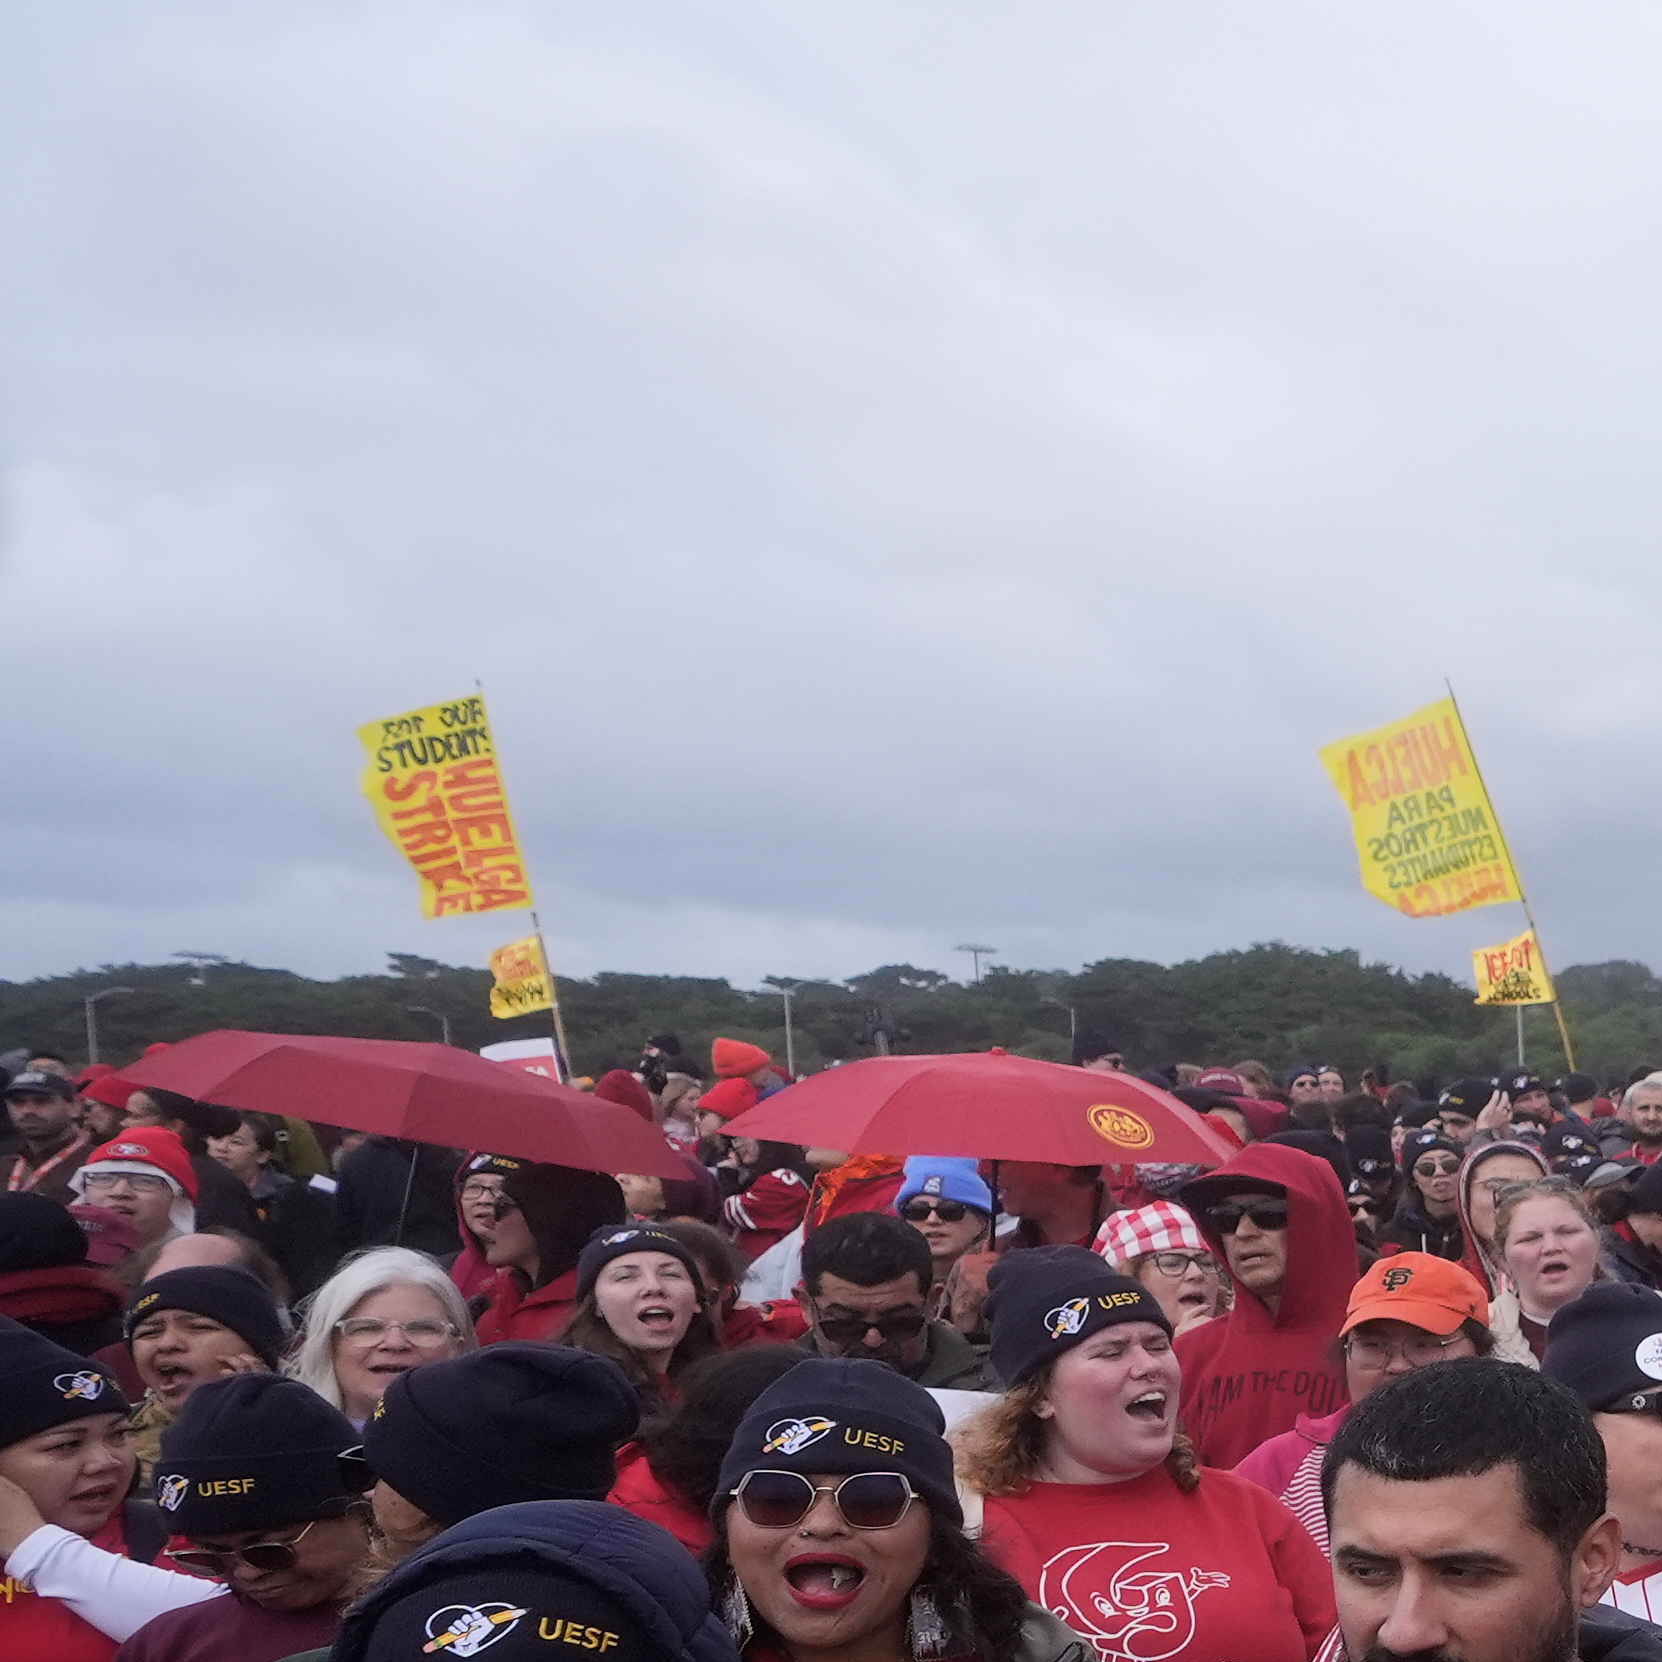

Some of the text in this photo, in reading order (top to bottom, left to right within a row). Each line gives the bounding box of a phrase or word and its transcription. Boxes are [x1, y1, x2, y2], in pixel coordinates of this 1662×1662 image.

[377, 727, 491, 773] STUDENTS
[384, 771, 475, 918] STRIKE
[442, 758, 528, 912] HUELGA
[1382, 1267, 1413, 1292] SF
[1097, 1289, 1143, 1312] UESF
[1252, 1370, 1290, 1393] THE
[843, 1426, 906, 1456] UESF
[197, 1477, 256, 1497] UESF
[537, 1616, 620, 1655] UESF
